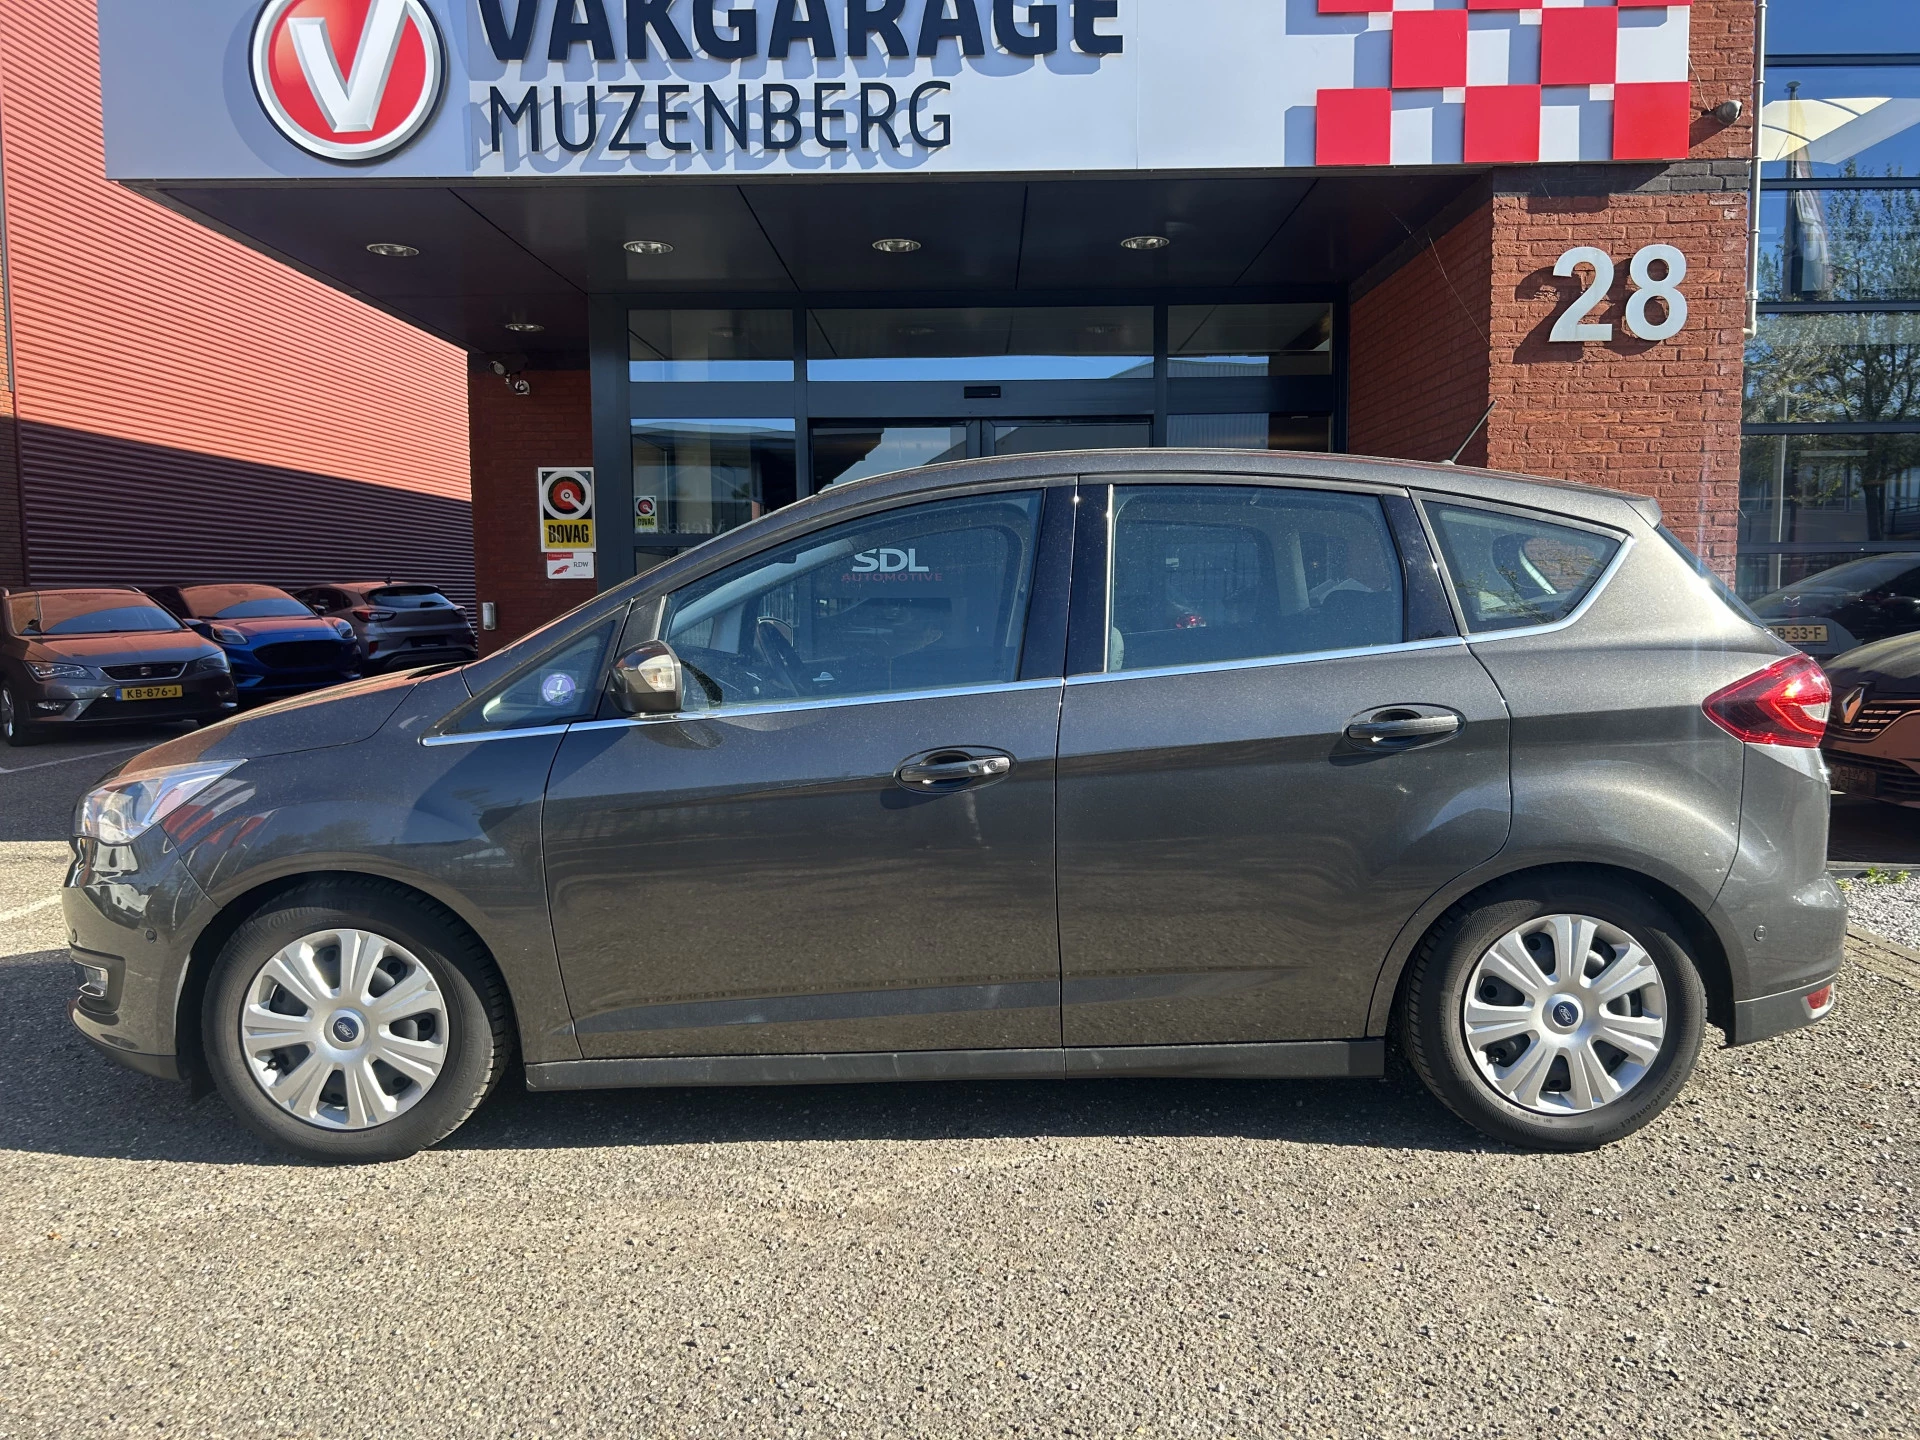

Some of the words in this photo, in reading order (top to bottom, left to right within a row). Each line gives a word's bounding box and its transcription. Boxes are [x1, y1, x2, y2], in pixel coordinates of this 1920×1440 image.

[478, 0, 1124, 61] VAKGARAGE
[287, 0, 408, 133] V
[489, 80, 951, 153] MUZENBERG
[1548, 243, 1688, 342] 28
[547, 524, 589, 543] BOVAG
[841, 572, 943, 582] AUTOMOTIVE
[851, 548, 929, 572] SDL
[127, 686, 178, 699] KB-876-J
